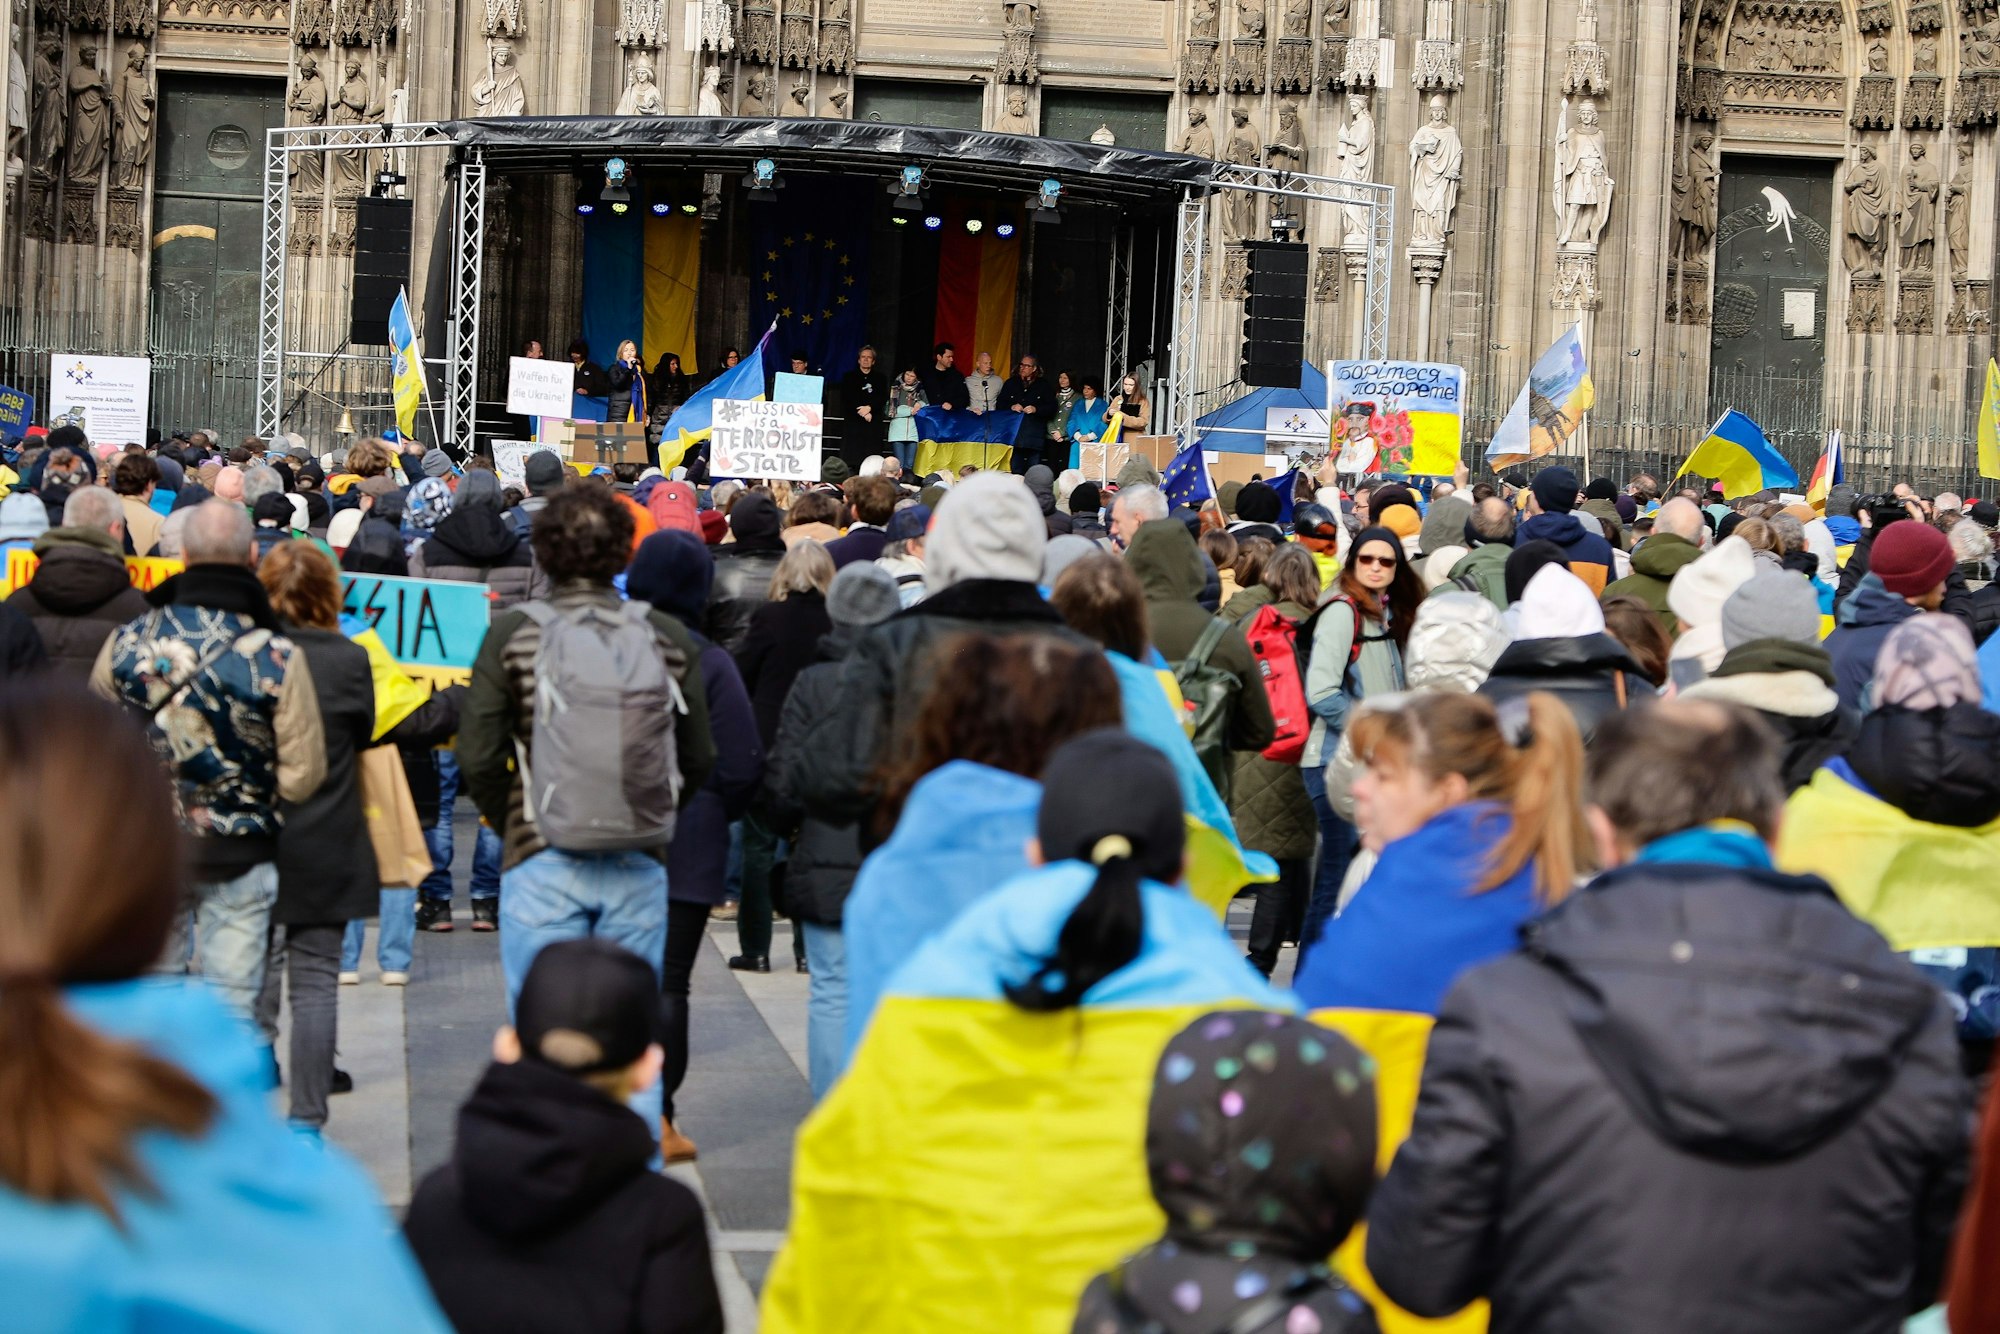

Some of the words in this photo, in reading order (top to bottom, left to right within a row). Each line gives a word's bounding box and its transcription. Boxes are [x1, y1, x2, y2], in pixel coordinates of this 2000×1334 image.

[517, 370, 549, 382] Waffen
[551, 373, 564, 384] für
[512, 387, 526, 398] die
[528, 389, 566, 402] Ukraine!
[754, 418, 767, 428] is
[770, 419, 780, 429] a
[712, 427, 822, 452] TERRORIST
